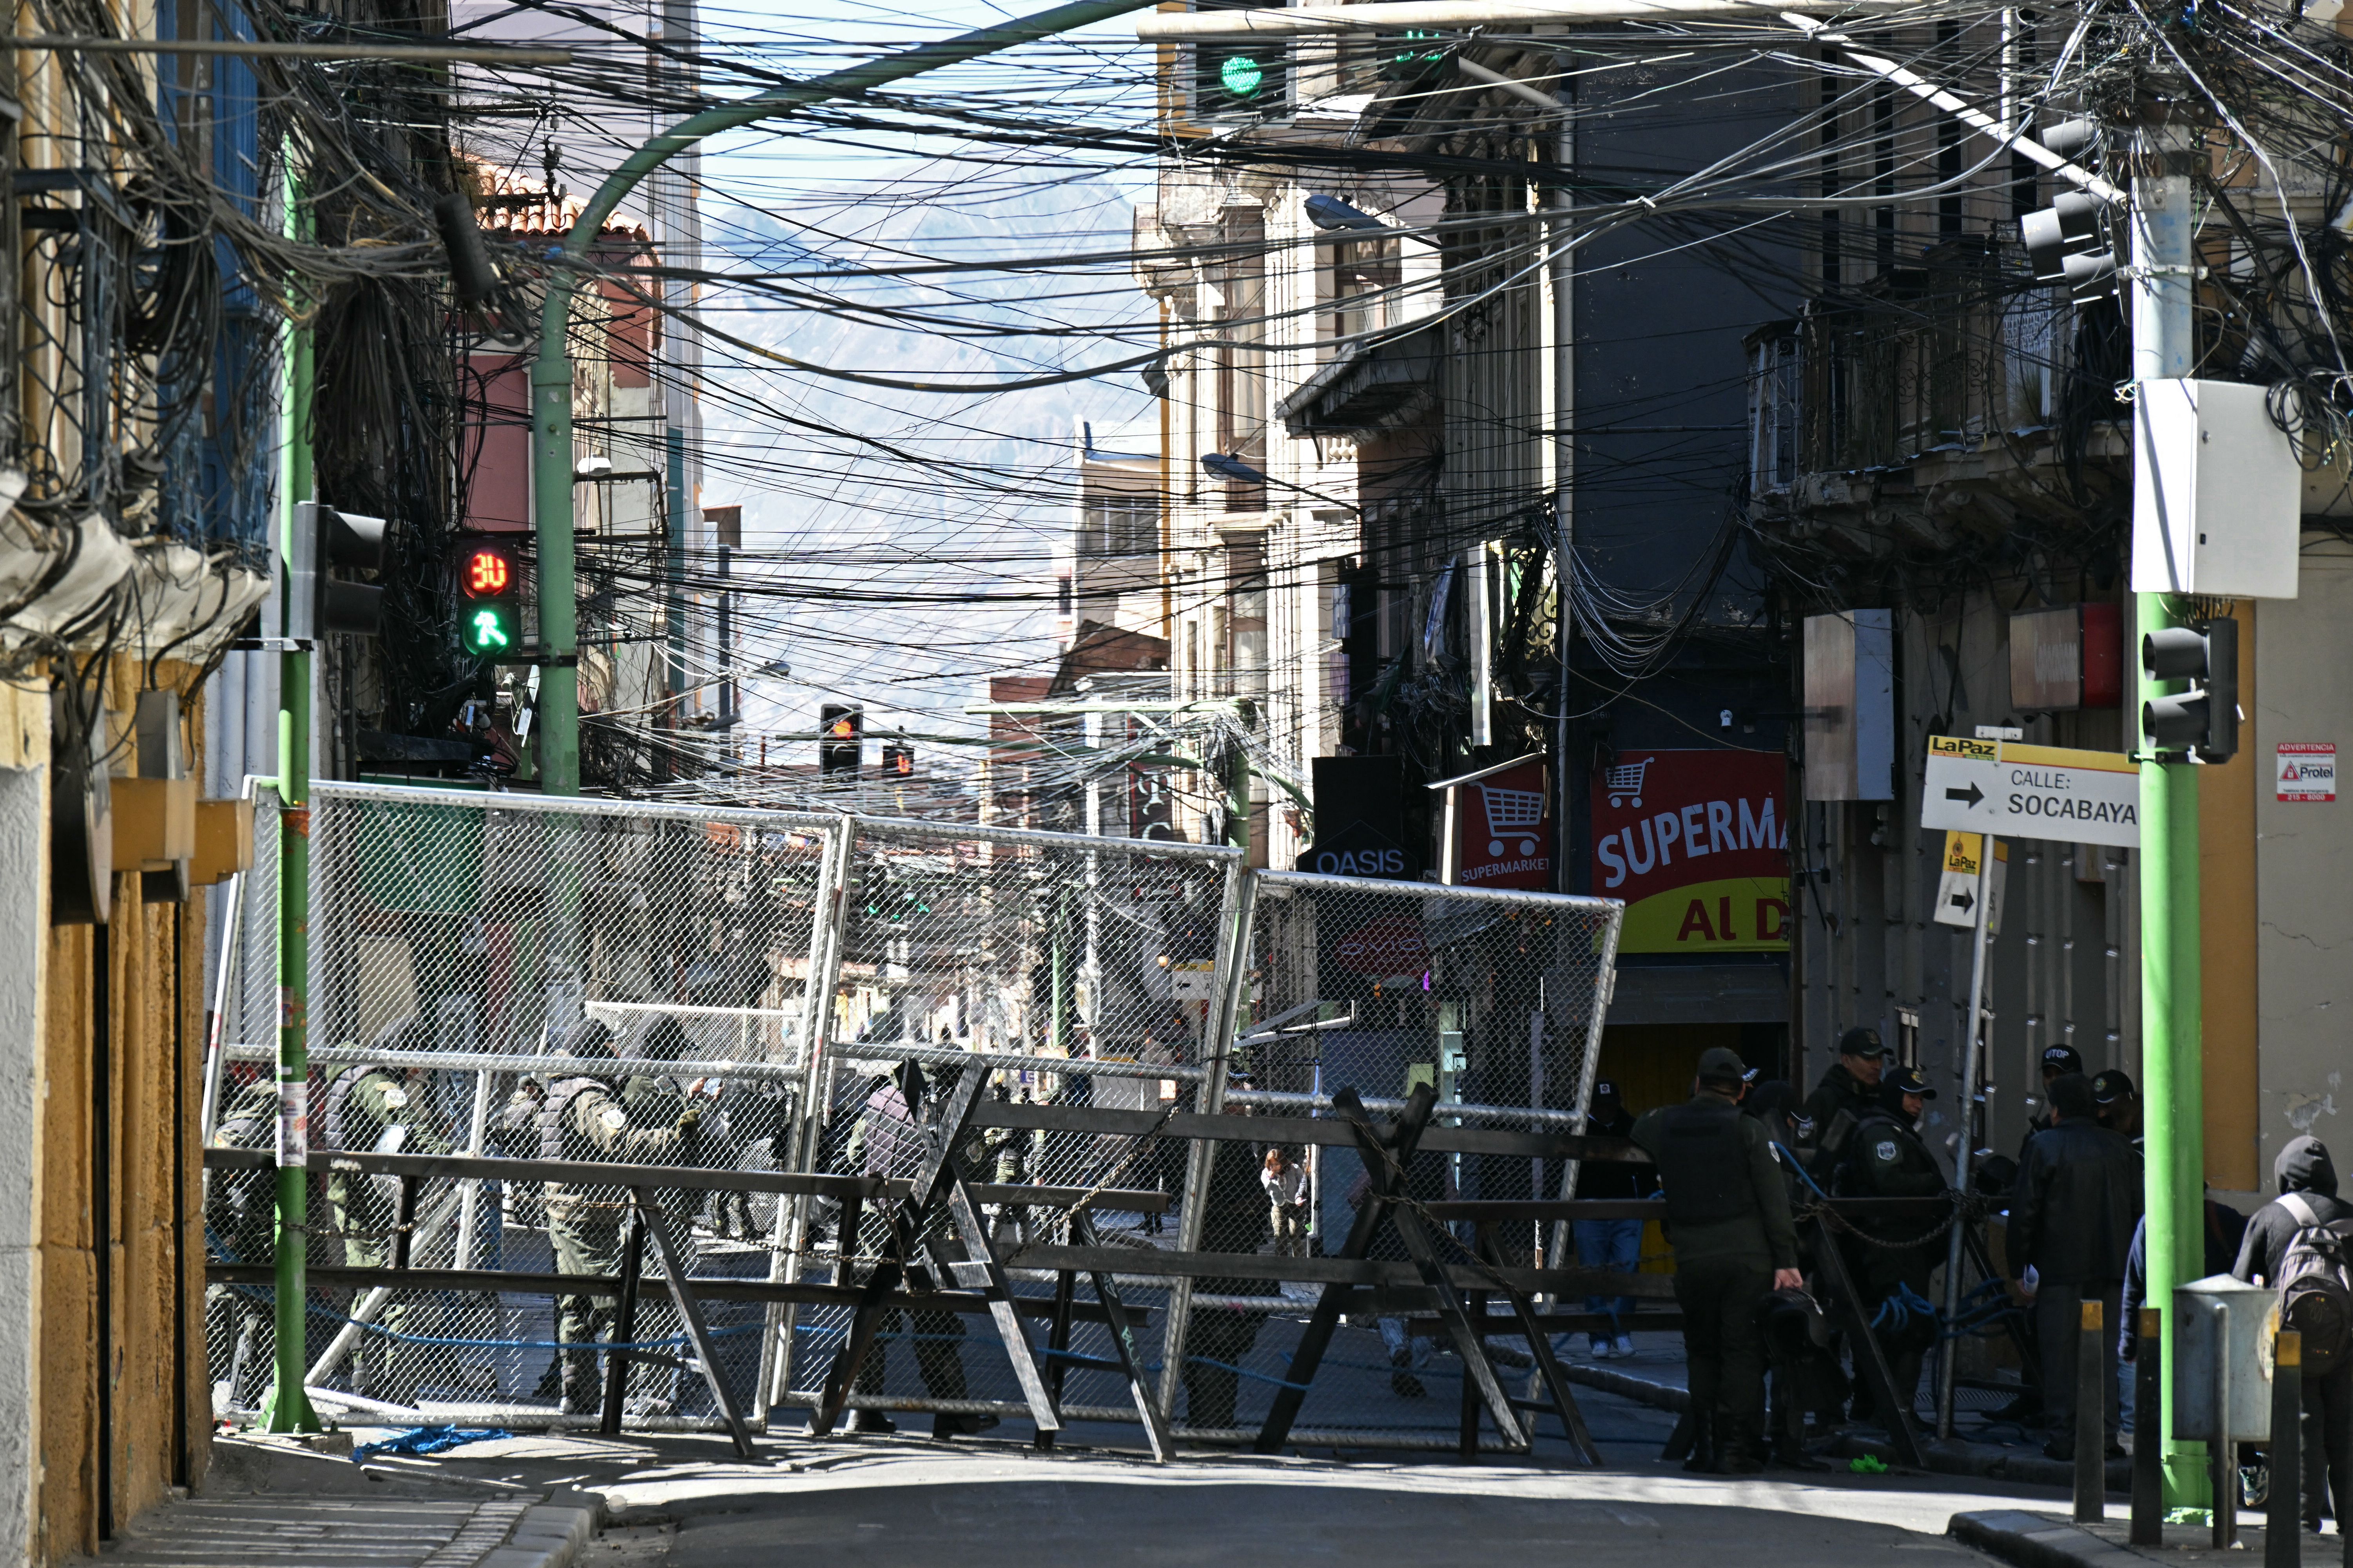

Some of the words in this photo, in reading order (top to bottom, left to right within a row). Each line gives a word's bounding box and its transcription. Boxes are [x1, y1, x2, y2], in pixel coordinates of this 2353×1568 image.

[2011, 770, 2070, 789] CALLE:
[2300, 767, 2333, 778] Protel
[2008, 793, 2137, 825] SOCABAYA
[1598, 798, 1788, 888] SUPERM
[1316, 849, 1404, 875] OASIS
[1461, 858, 1549, 882] SUPERMARKET
[2045, 1049, 2069, 1059] UTOP
